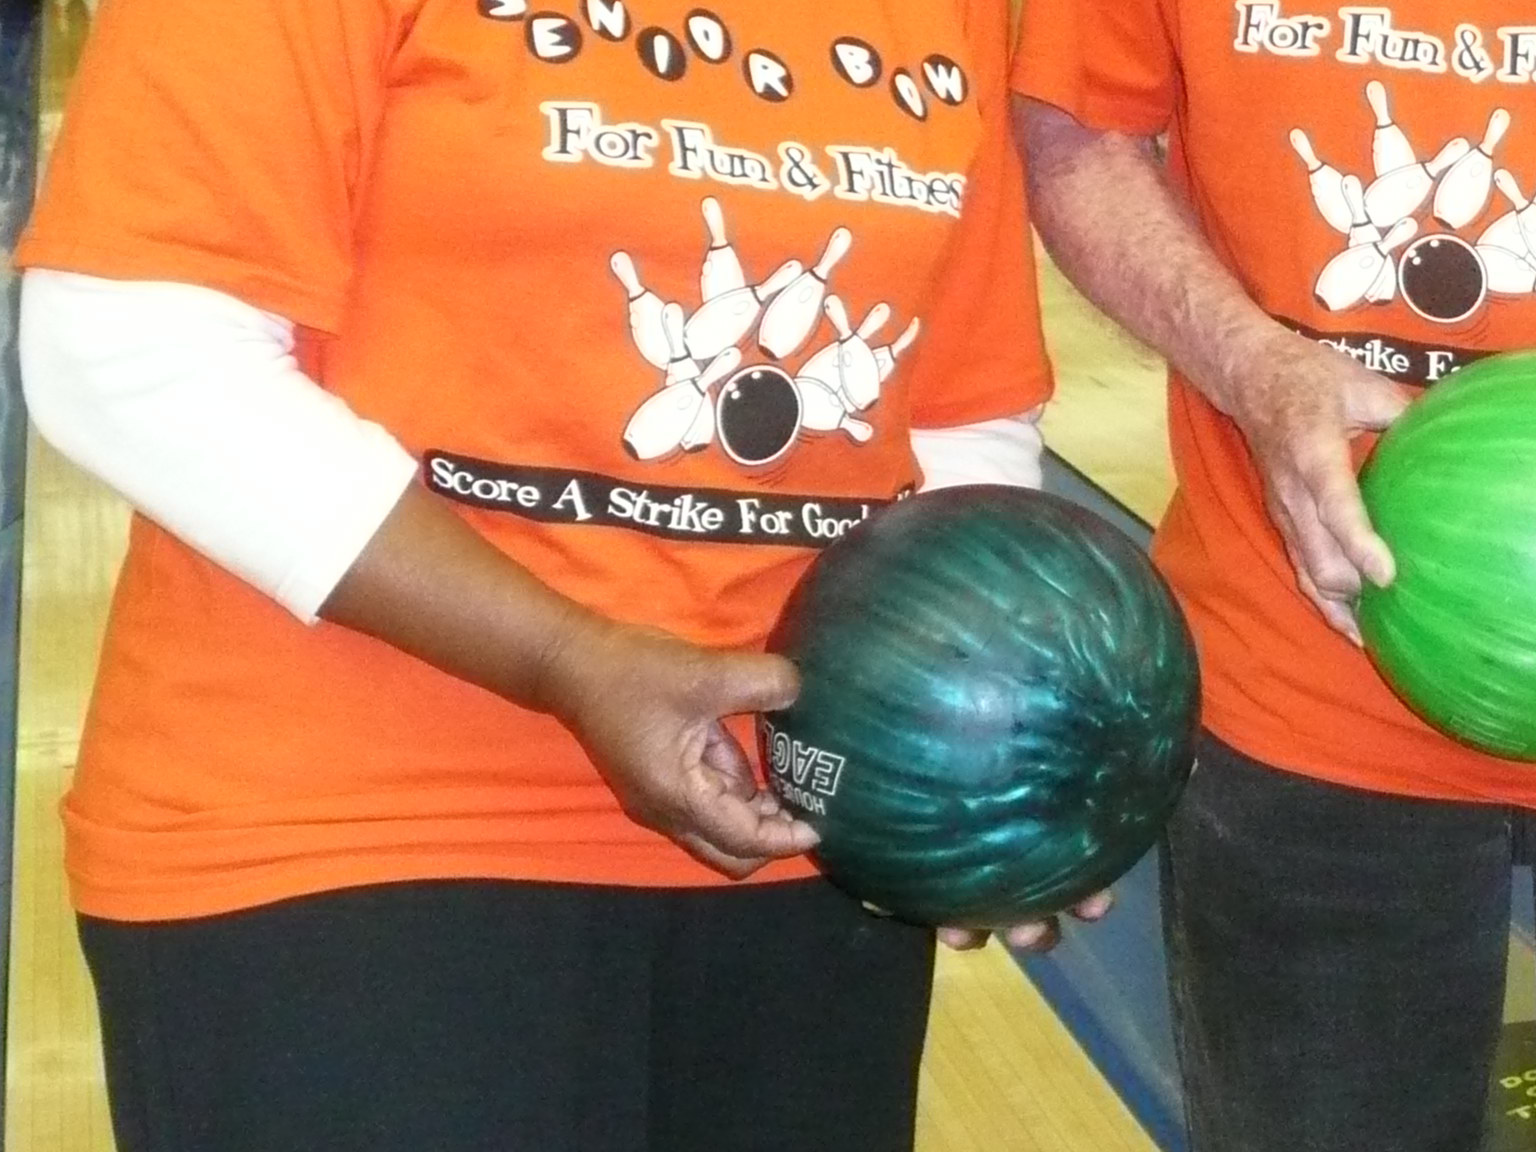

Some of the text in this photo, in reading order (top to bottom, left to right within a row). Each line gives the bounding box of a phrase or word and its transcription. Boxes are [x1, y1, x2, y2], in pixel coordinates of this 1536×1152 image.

[1236, 0, 1327, 53] For
[1341, 10, 1443, 70] Fun
[1457, 27, 1488, 79] &
[546, 104, 656, 164] For
[667, 122, 775, 186] Fun
[781, 144, 826, 196] &
[431, 457, 541, 506] Score
[553, 479, 592, 522] A
[607, 487, 724, 533] Strike
[737, 499, 793, 534] For
